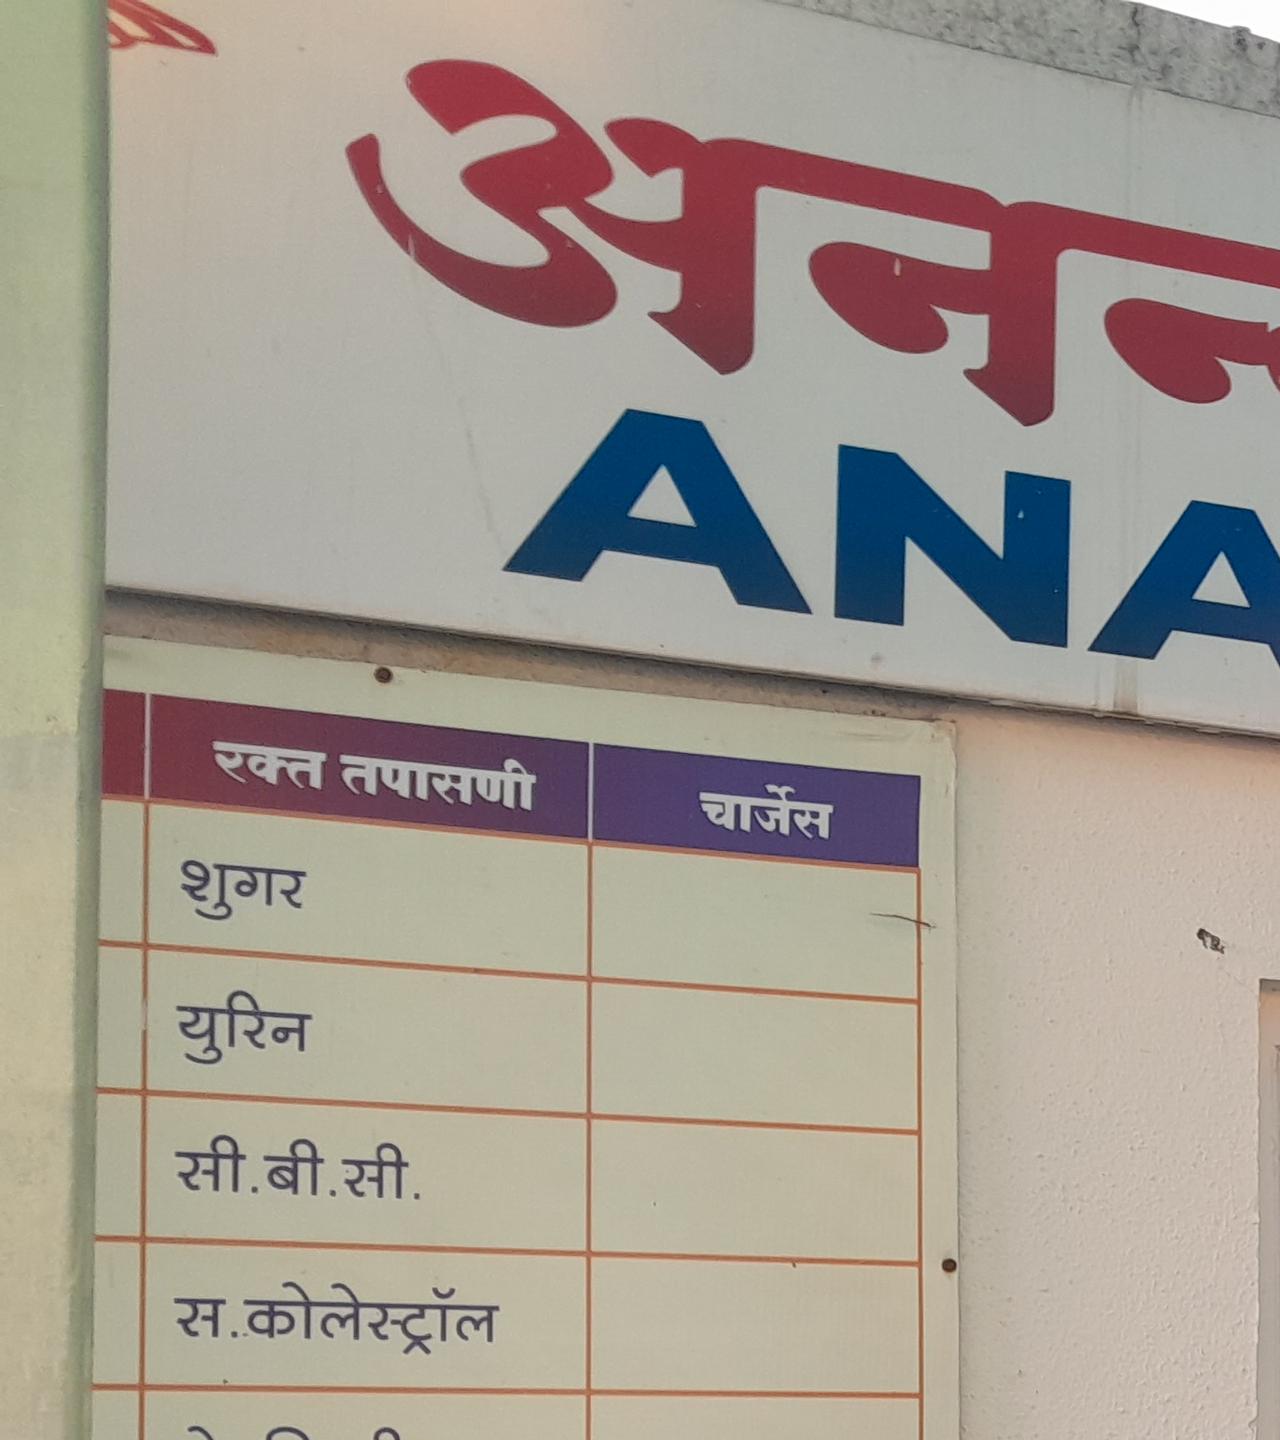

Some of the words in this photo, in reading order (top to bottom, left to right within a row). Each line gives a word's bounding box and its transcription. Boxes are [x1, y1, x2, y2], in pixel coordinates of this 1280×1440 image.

[213, 740, 326, 789] रक्त
[339, 754, 536, 810] तपासणी
[699, 785, 833, 838] चार्जेस
[180, 859, 306, 920] शुगर
[176, 990, 312, 1064] युरिन
